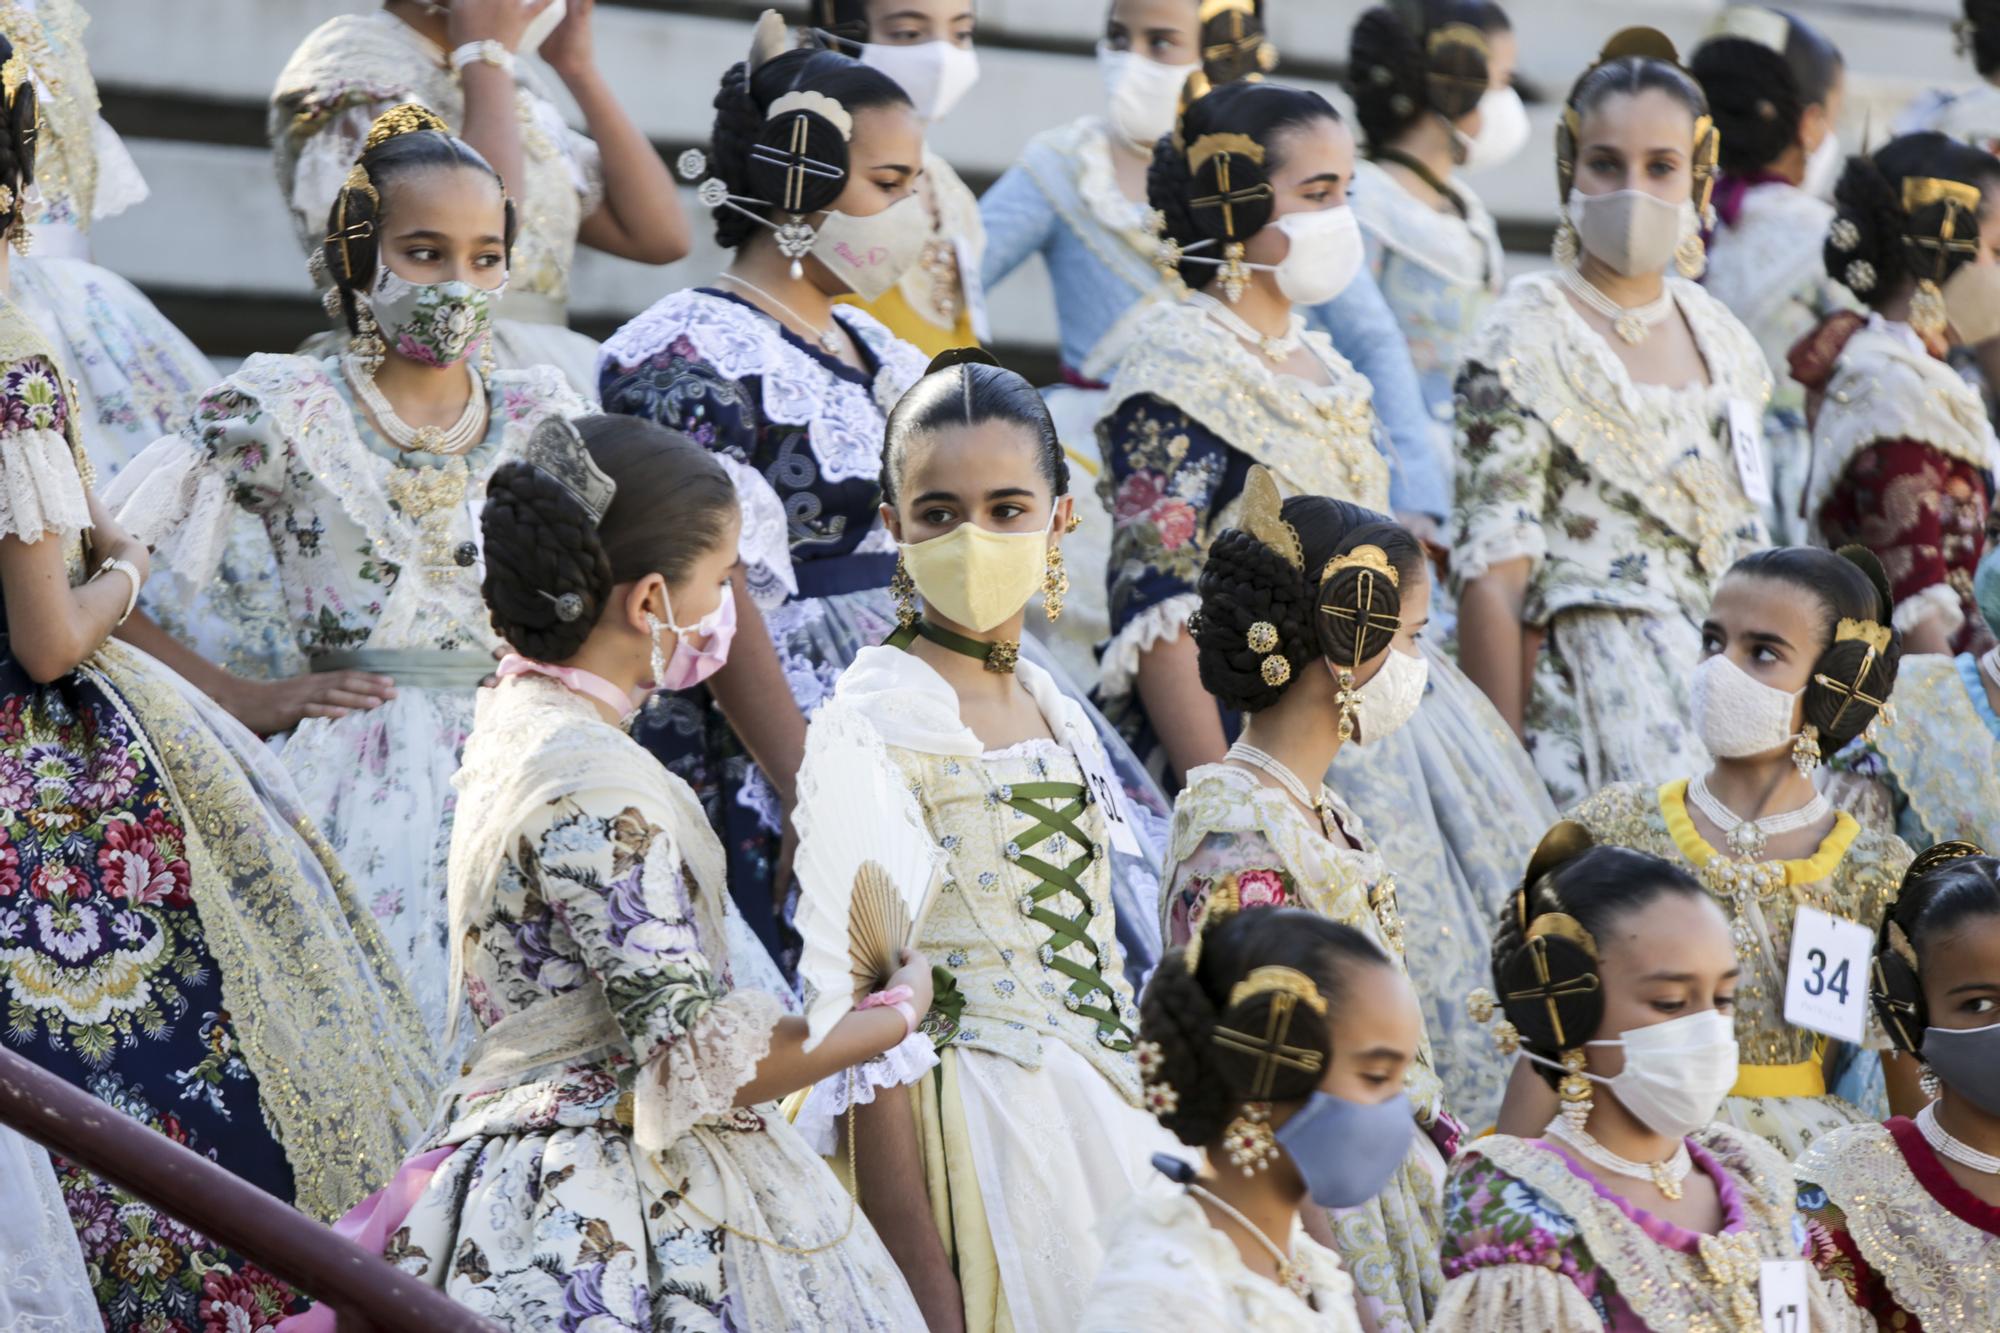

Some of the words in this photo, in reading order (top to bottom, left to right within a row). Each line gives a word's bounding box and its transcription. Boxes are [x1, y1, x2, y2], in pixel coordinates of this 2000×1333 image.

[1091, 772, 1124, 824] 32
[1804, 947, 1850, 1005] 34
[1775, 1304, 1798, 1333] 17
